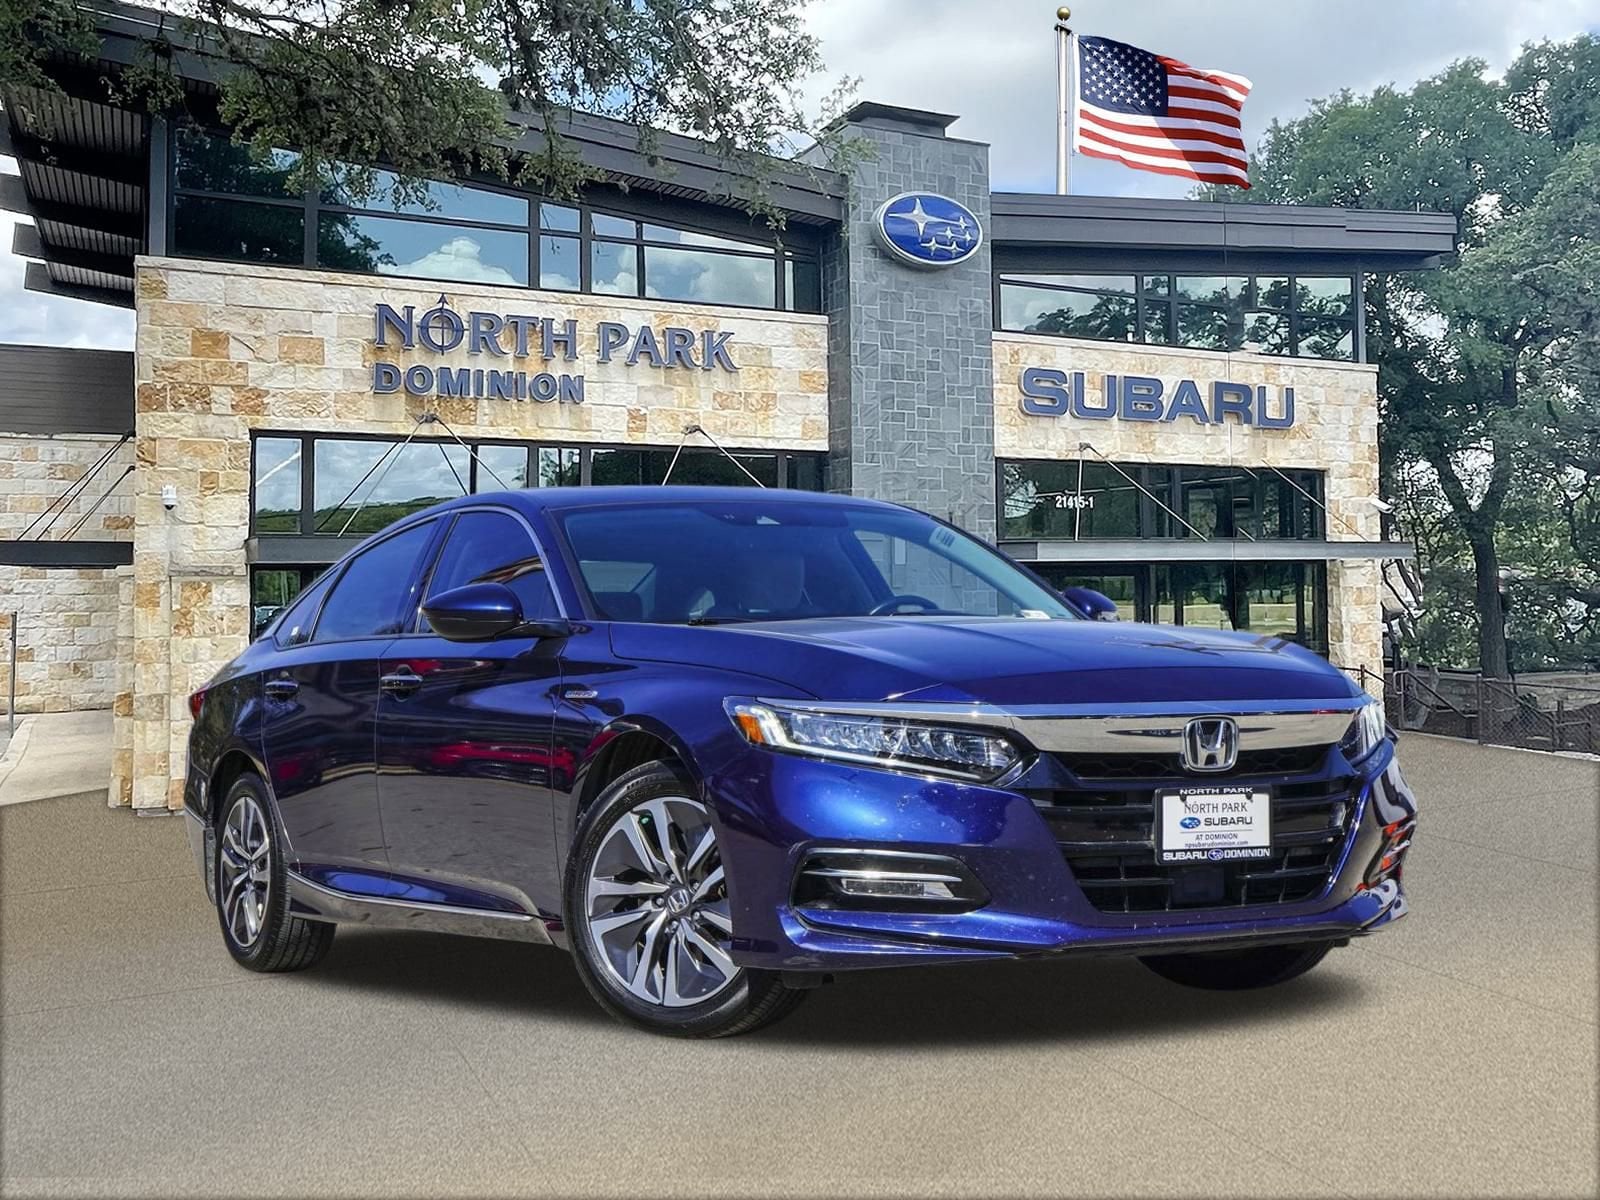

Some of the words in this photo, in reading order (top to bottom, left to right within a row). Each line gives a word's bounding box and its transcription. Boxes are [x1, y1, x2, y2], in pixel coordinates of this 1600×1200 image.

[374, 295, 579, 361] NORTH
[598, 321, 741, 372] PARK
[372, 362, 585, 403] DOMINION
[1019, 367, 1295, 430] SUBARU
[1184, 801, 1219, 814] NORTH
[1221, 802, 1248, 813] PARK
[1204, 817, 1253, 826] SUBARU
[1204, 832, 1238, 841] DOMINION
[1162, 851, 1208, 861] SUBARU
[1224, 848, 1271, 859] DOMINION
